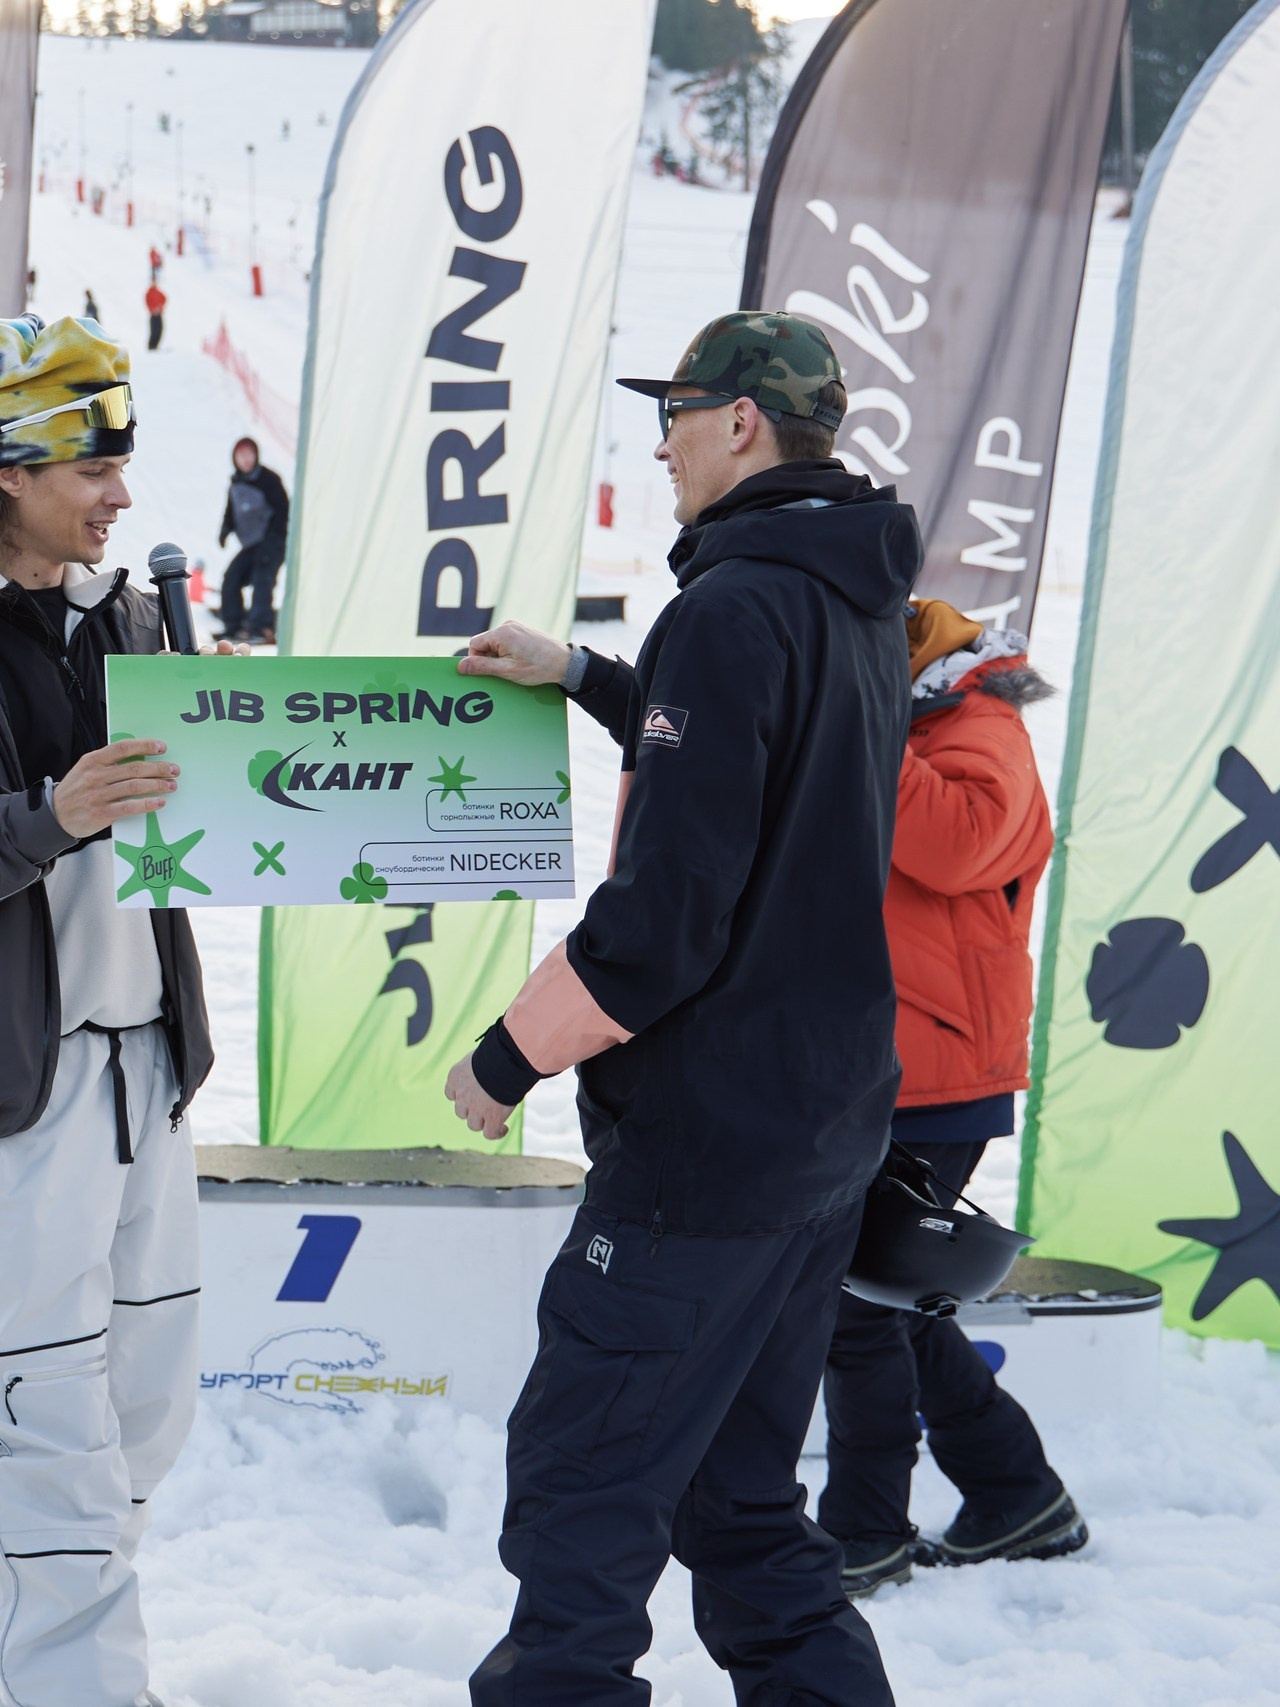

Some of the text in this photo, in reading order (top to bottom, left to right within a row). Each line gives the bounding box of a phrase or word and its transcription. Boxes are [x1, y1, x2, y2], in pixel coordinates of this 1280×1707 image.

[416, 124, 528, 650] PRING
[960, 416, 1044, 638] AMP
[179, 689, 494, 727] JIB SPRING
[287, 762, 414, 791] КАНТ
[440, 813, 496, 822] горнолыжные
[462, 802, 495, 811] ботинки
[500, 802, 560, 820] ROXA
[375, 865, 445, 874] сноубордические
[412, 854, 445, 863] ботинки
[450, 853, 562, 872] NIDECKER
[275, 1214, 362, 1303] 1
[200, 1372, 449, 1397] УРОРТ СНЕЖНЫЙ
